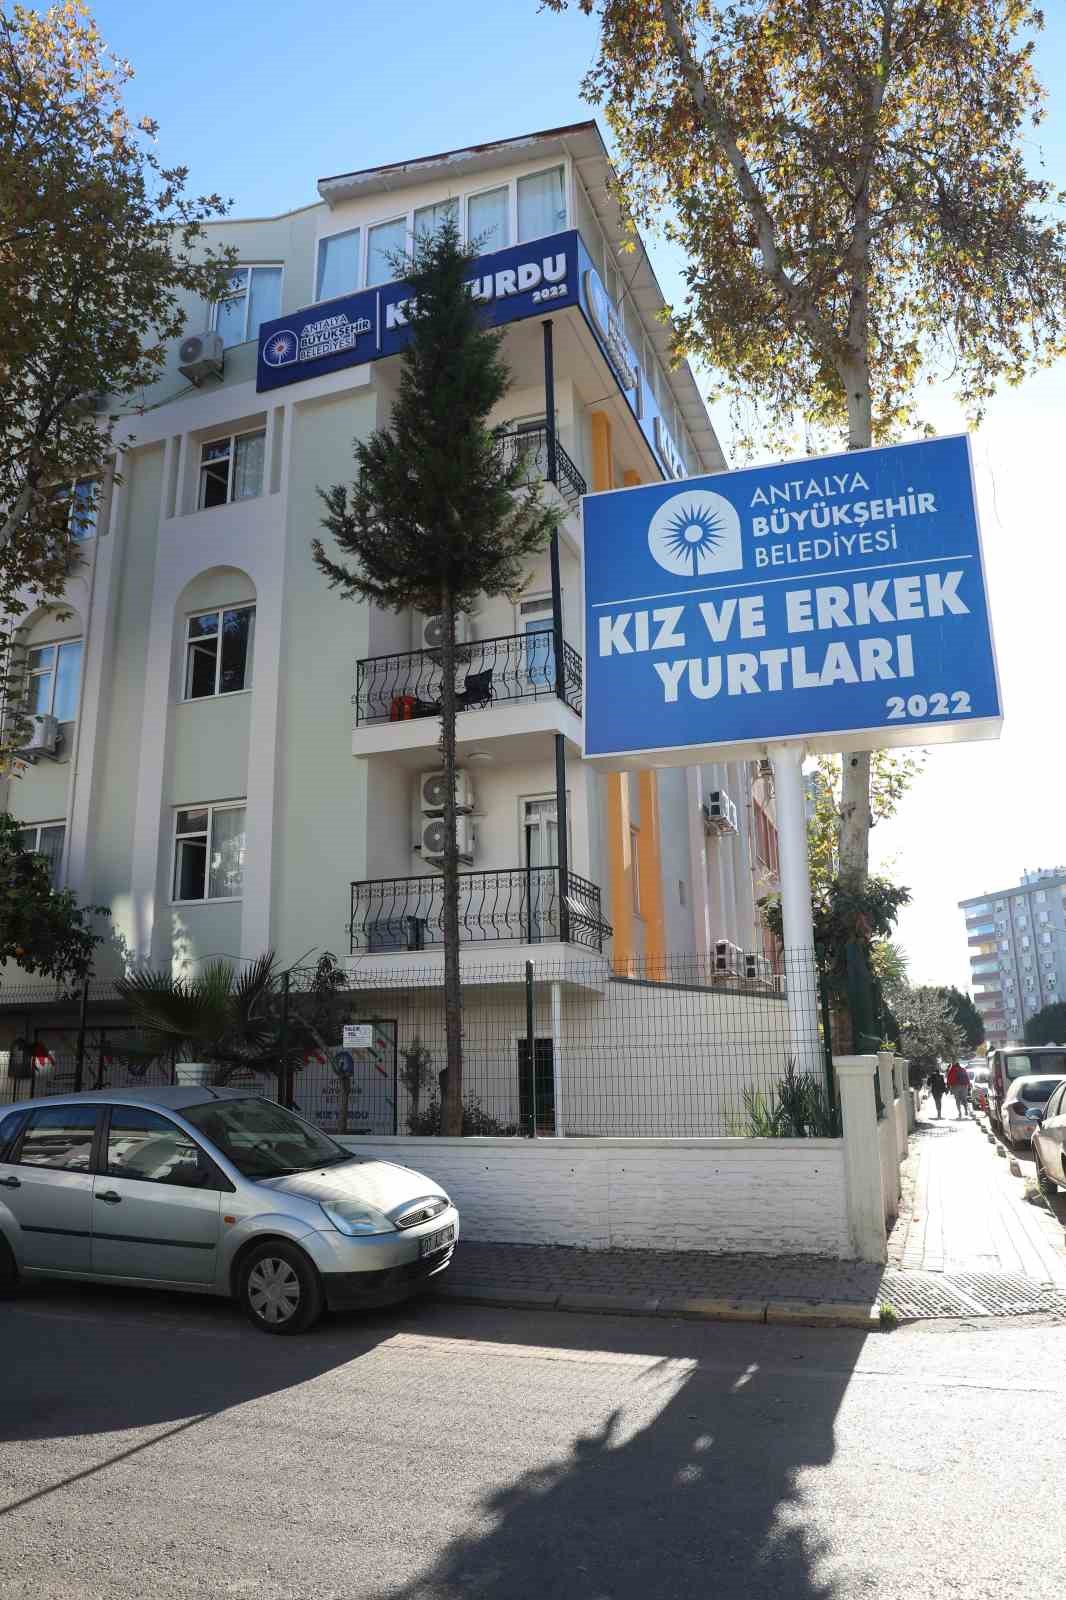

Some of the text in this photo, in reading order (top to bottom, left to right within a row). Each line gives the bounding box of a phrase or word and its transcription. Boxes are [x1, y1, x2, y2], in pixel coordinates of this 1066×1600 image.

[464, 253, 567, 301] URDU
[532, 284, 568, 304] 2022
[301, 314, 349, 336] ANTALYA
[750, 472, 870, 508] ANTALYA
[752, 486, 938, 537] BÜYÜKŞEHİR
[755, 523, 898, 568] BELEDİYESİ
[599, 571, 971, 657] KIZ VE ERKEK
[654, 634, 915, 703] YURTLARI
[885, 690, 973, 720] 2022
